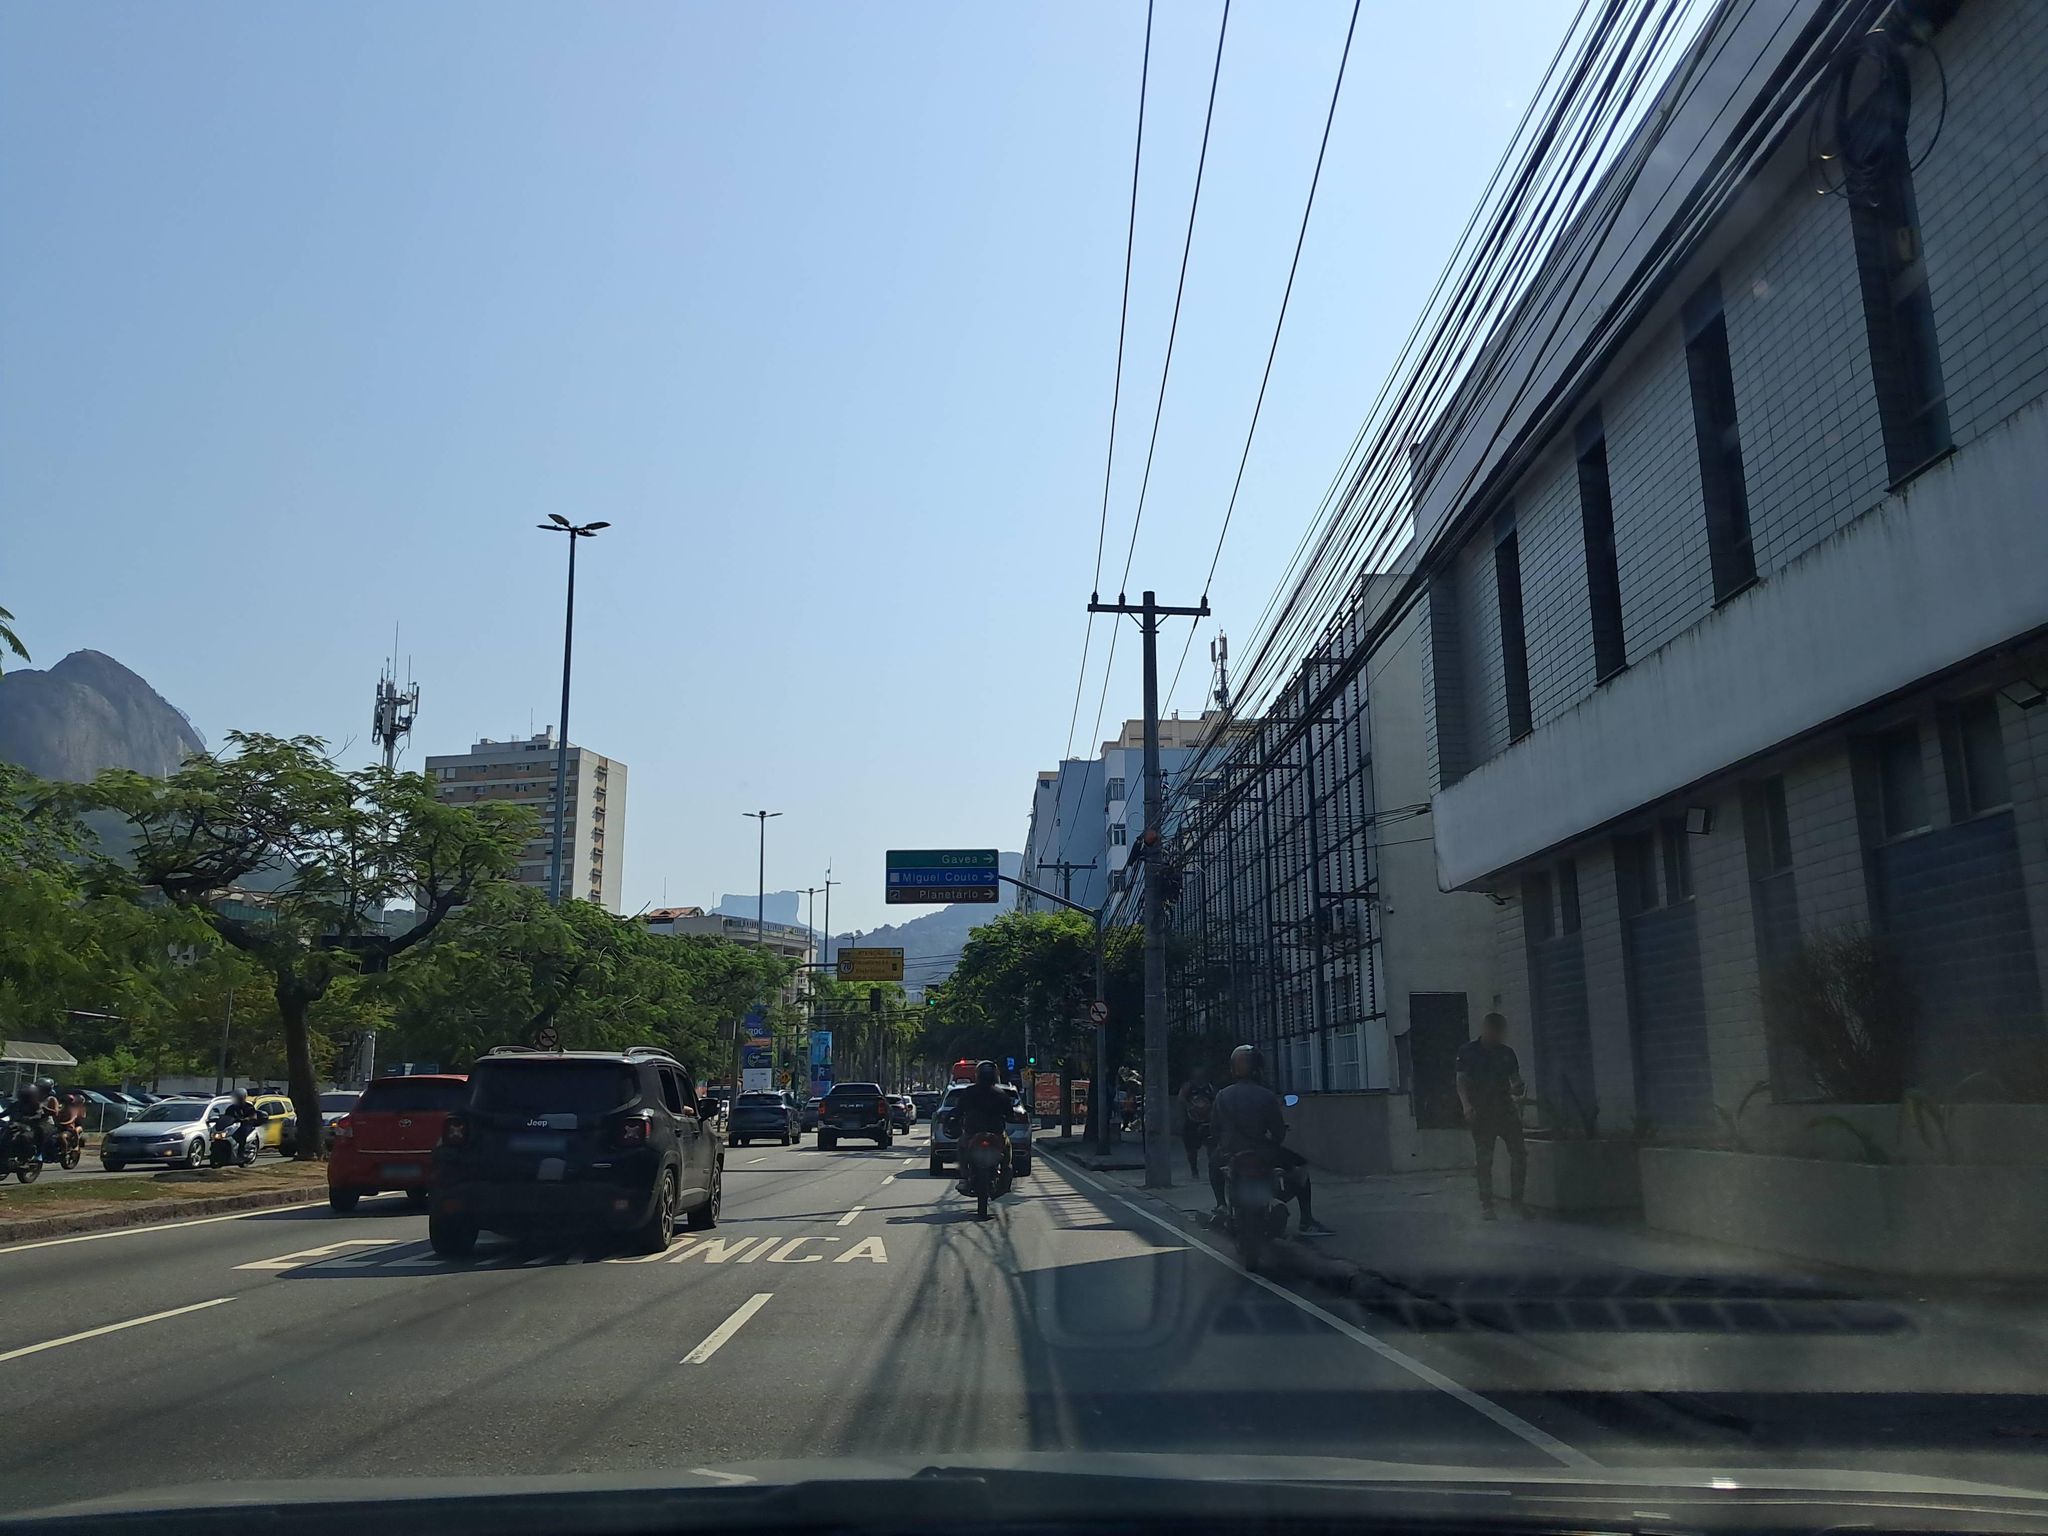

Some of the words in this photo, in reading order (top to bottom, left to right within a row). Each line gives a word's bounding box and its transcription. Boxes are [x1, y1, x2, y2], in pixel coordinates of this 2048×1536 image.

[902, 871, 940, 884] Miguel
[945, 871, 979, 882] Couto
[527, 1118, 548, 1128] Jeep
